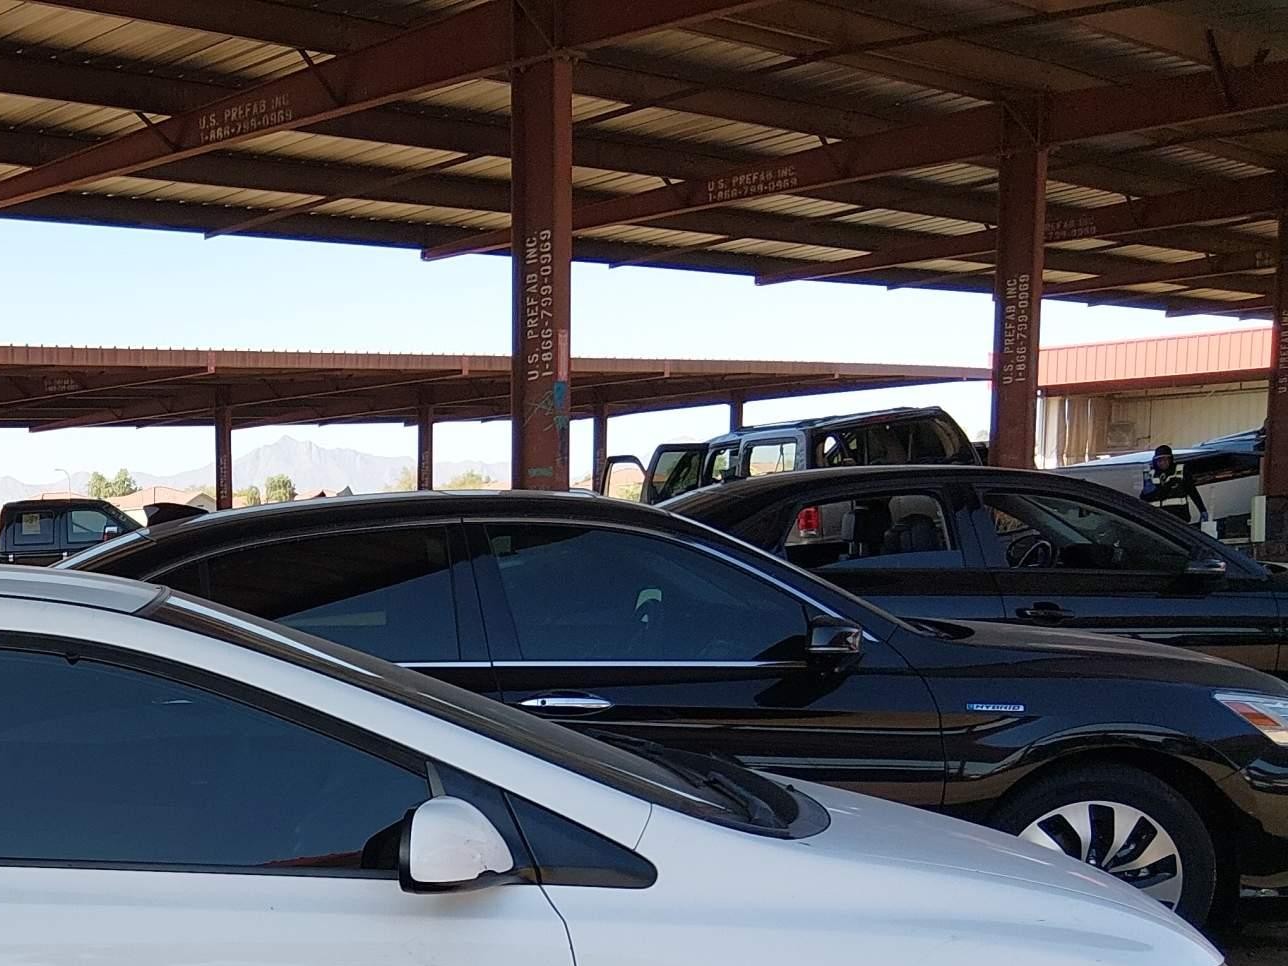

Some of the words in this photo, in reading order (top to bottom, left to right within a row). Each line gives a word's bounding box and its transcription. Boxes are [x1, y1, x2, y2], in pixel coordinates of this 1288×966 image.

[526, 231, 538, 265] INC.
[526, 273, 539, 339] PREFAB
[540, 229, 553, 377] 1-866-799-0969
[1004, 305, 1016, 354] PREFAB
[1015, 274, 1030, 382] 1-866-799-0969
[527, 348, 539, 381] U.S.
[1003, 359, 1015, 384] U.S.
